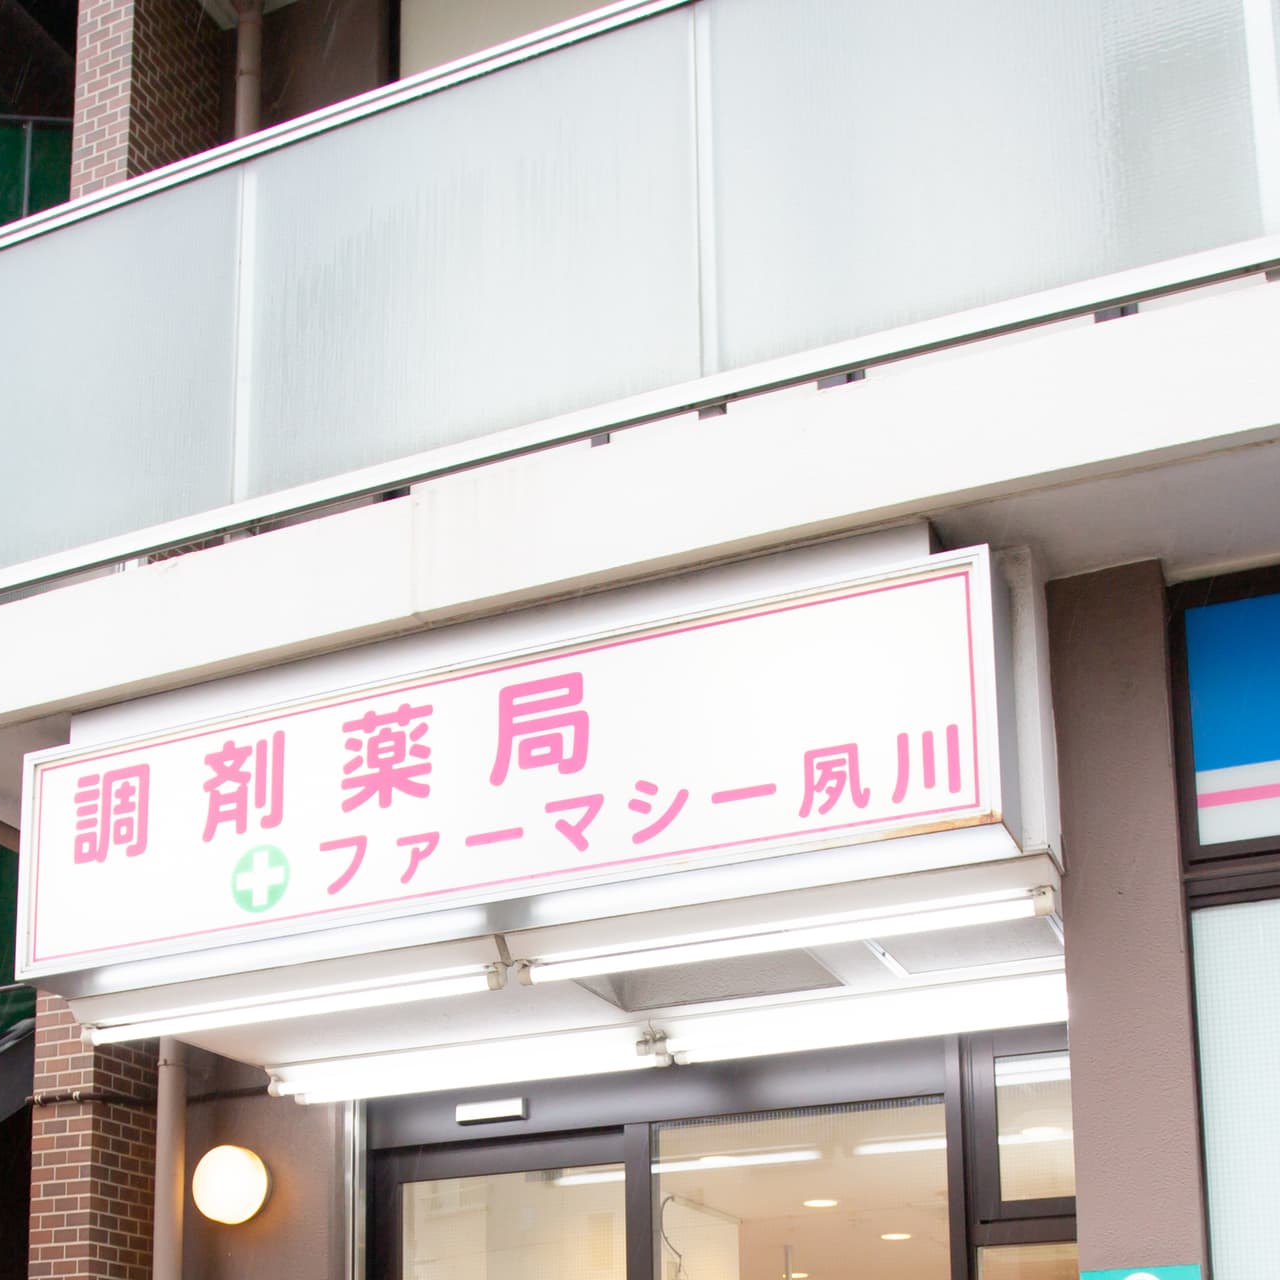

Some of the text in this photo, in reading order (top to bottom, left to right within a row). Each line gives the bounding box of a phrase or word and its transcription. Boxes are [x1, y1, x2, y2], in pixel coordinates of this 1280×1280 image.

[72, 671, 590, 865] 調剤薬局
[320, 722, 963, 896] ファーマシー夙川
